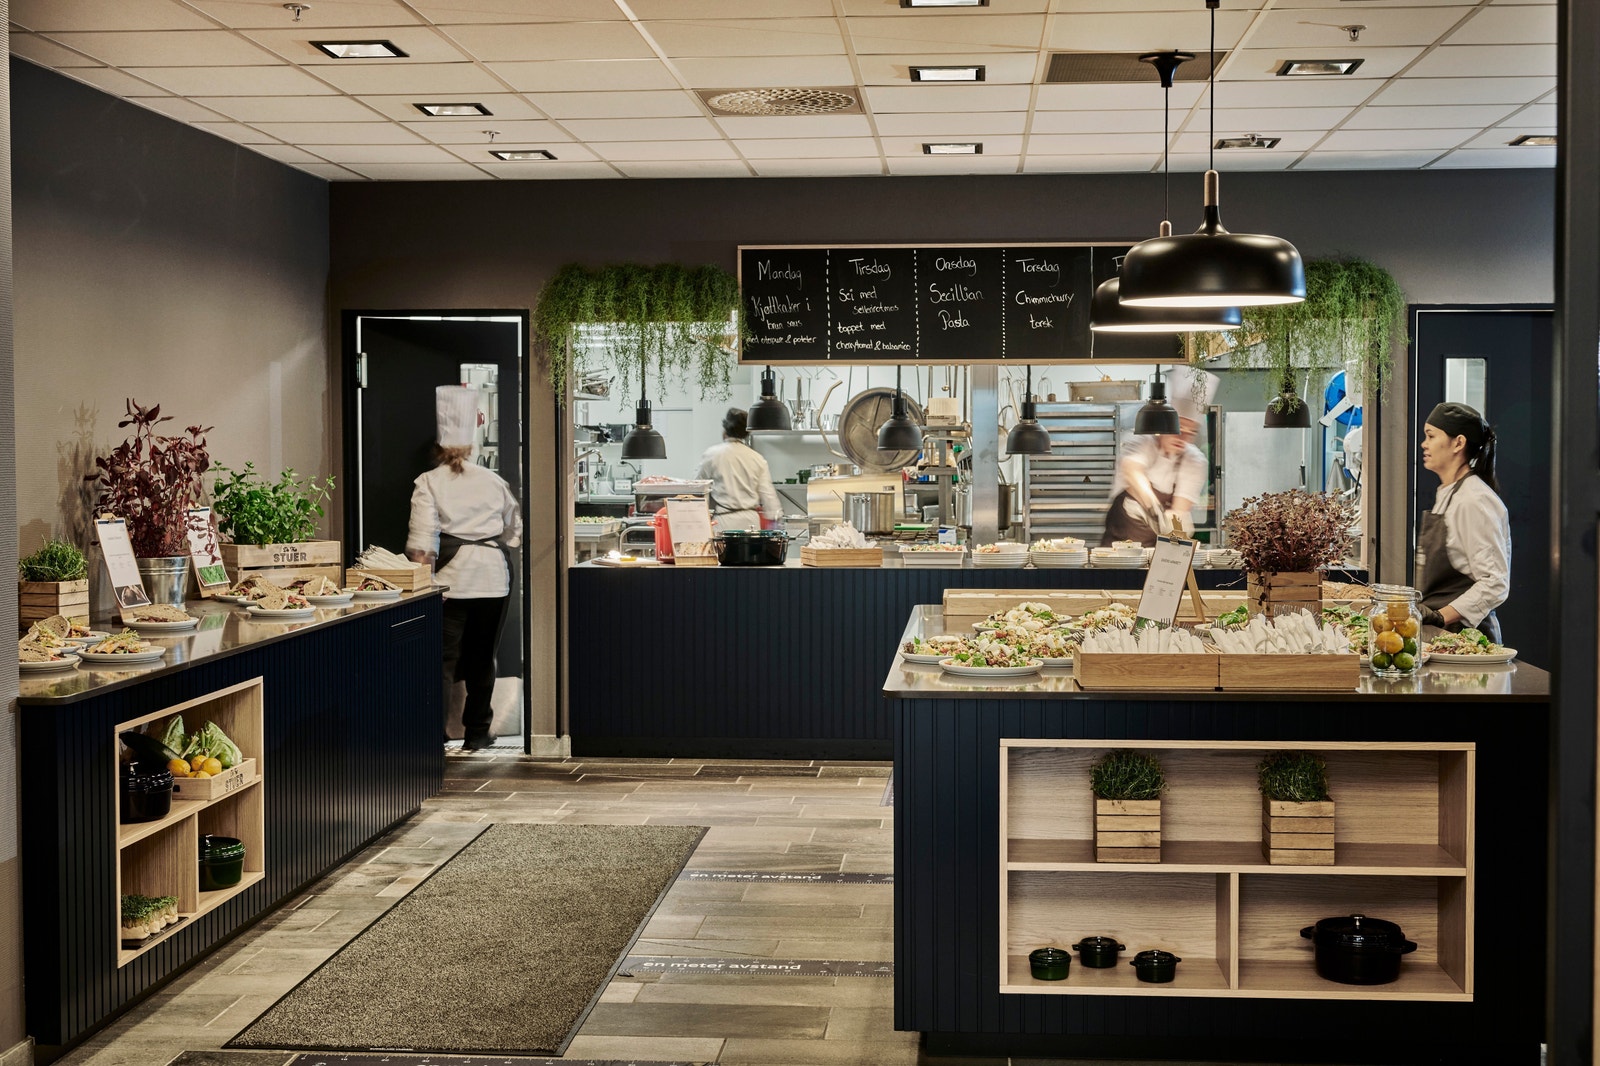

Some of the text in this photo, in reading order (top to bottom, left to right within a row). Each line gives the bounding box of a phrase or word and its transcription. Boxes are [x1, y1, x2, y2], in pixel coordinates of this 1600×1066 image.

[758, 259, 802, 291] Mandag
[849, 258, 891, 281] Tirsdag
[935, 256, 977, 277] Onsdag
[1015, 258, 1060, 288] Torsdag
[839, 285, 877, 302] Sei med
[929, 283, 984, 303] Secillian
[805, 297, 811, 311] i
[766, 320, 784, 330] brun
[837, 321, 886, 335] toppet med
[938, 309, 970, 330] Pasta
[1029, 313, 1054, 329] torsk
[273, 552, 307, 563] STUER
[670, 961, 725, 969] meter
[729, 963, 802, 971] avstand
